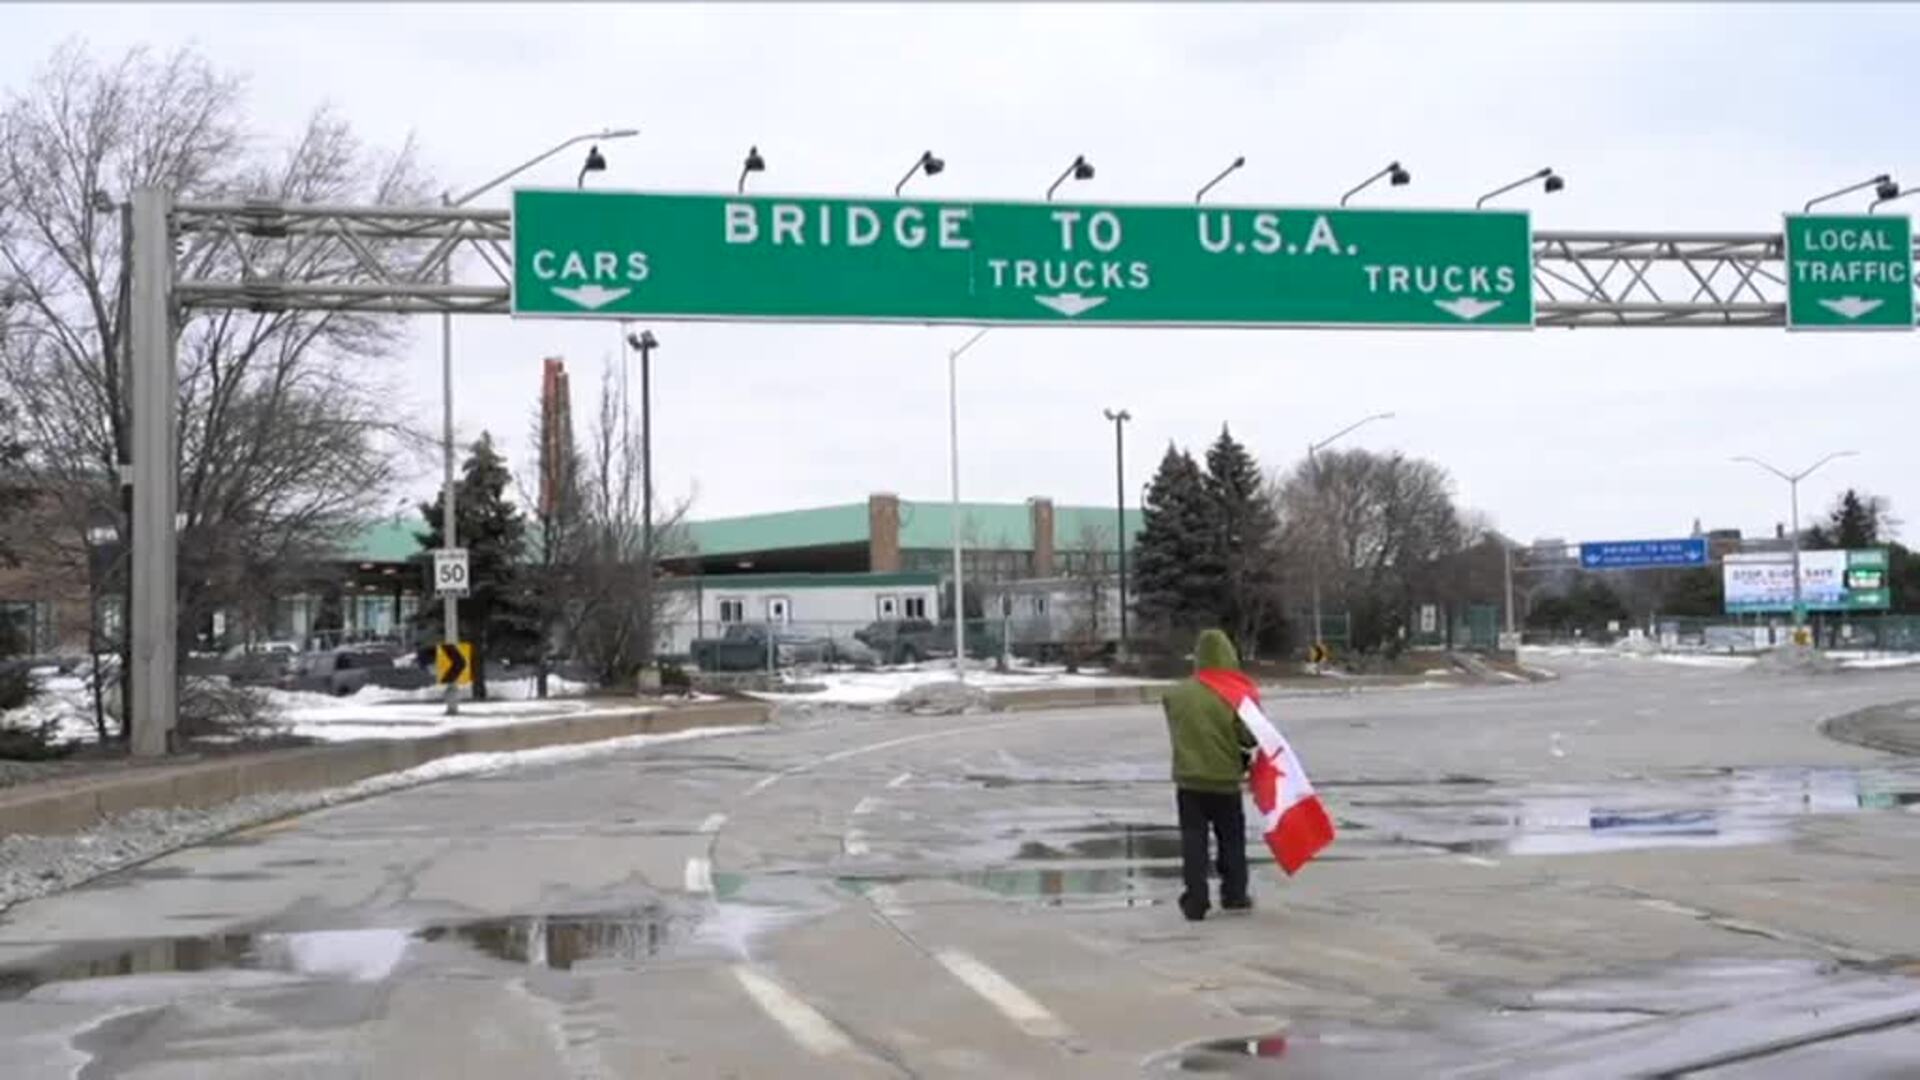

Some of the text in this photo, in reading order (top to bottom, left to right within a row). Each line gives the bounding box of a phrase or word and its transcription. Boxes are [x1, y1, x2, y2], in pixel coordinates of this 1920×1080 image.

[725, 202, 1358, 255] BRIDGE TO U.S.A.
[1803, 229, 1893, 251] LOCAL
[534, 250, 649, 280] CARS
[989, 260, 1151, 290] TRUCKS
[1365, 265, 1515, 295] TRUCKS
[1795, 261, 1906, 283] TRAFFIC
[441, 564, 465, 583] 50
